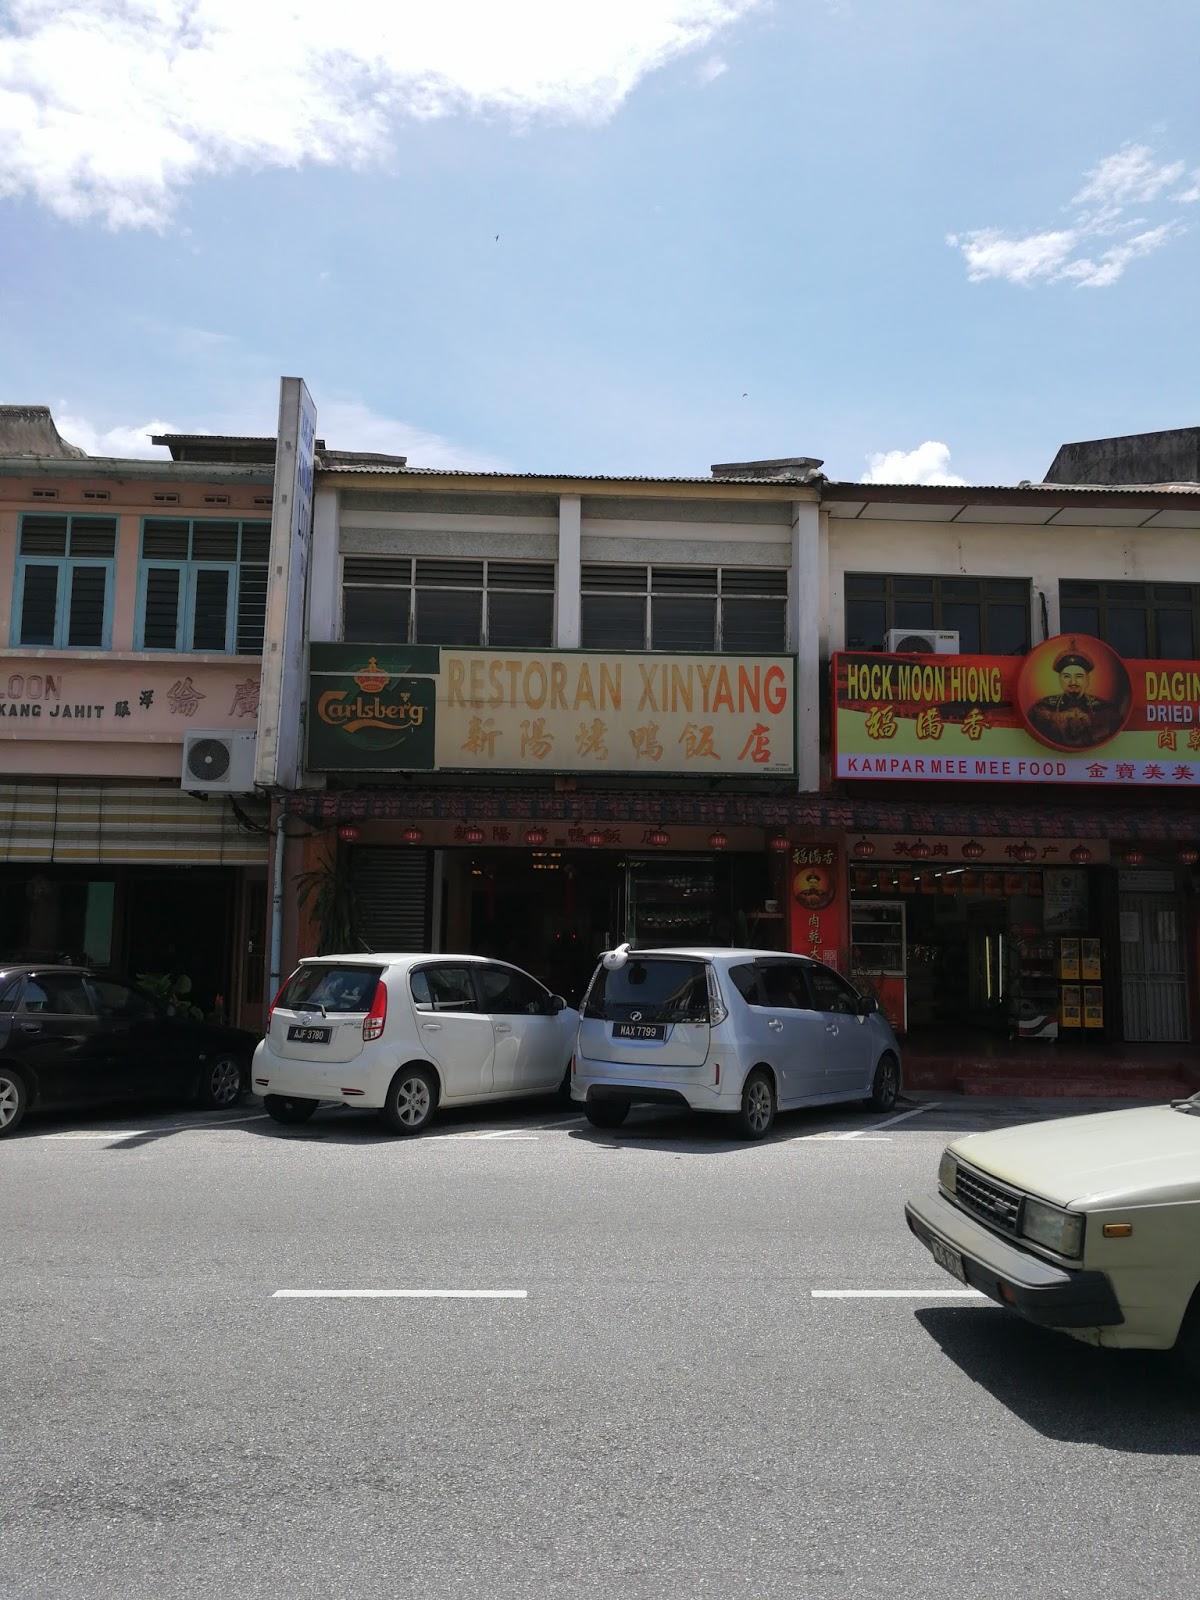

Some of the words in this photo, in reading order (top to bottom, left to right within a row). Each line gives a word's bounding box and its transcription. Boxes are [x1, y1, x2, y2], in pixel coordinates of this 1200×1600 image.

[0, 674, 62, 701] OON
[448, 659, 622, 711] RESTORAN
[637, 663, 787, 714] XINYANG
[847, 664, 893, 700] HOCK
[899, 665, 945, 701] MOON
[951, 666, 1001, 702] HIONG
[50, 703, 104, 719] JAHIT
[317, 689, 424, 727] Carlsberg
[1147, 704, 1193, 723] DRIED
[848, 758, 925, 773] KAMPAR
[931, 759, 967, 774] MEE
[975, 760, 1011, 775] MEE
[1018, 762, 1066, 776] FOOD
[636, 1026, 656, 1037] 7799
